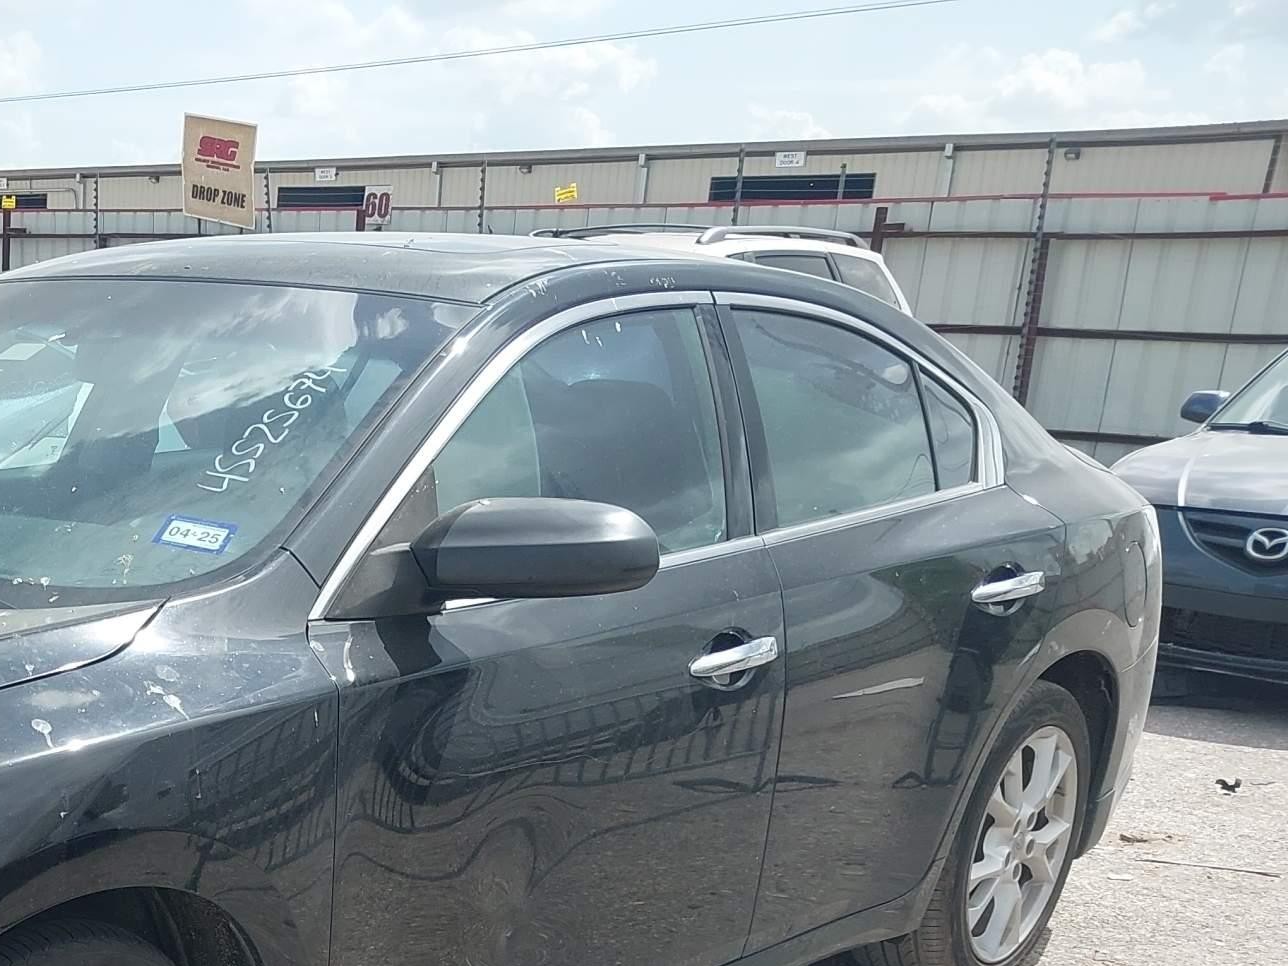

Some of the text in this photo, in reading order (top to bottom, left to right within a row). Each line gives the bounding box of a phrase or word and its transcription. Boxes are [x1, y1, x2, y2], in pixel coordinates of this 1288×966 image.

[197, 136, 240, 161] SRG
[192, 184, 246, 208] DROP ZONE
[365, 192, 390, 218] 60
[197, 366, 347, 492] 45525674
